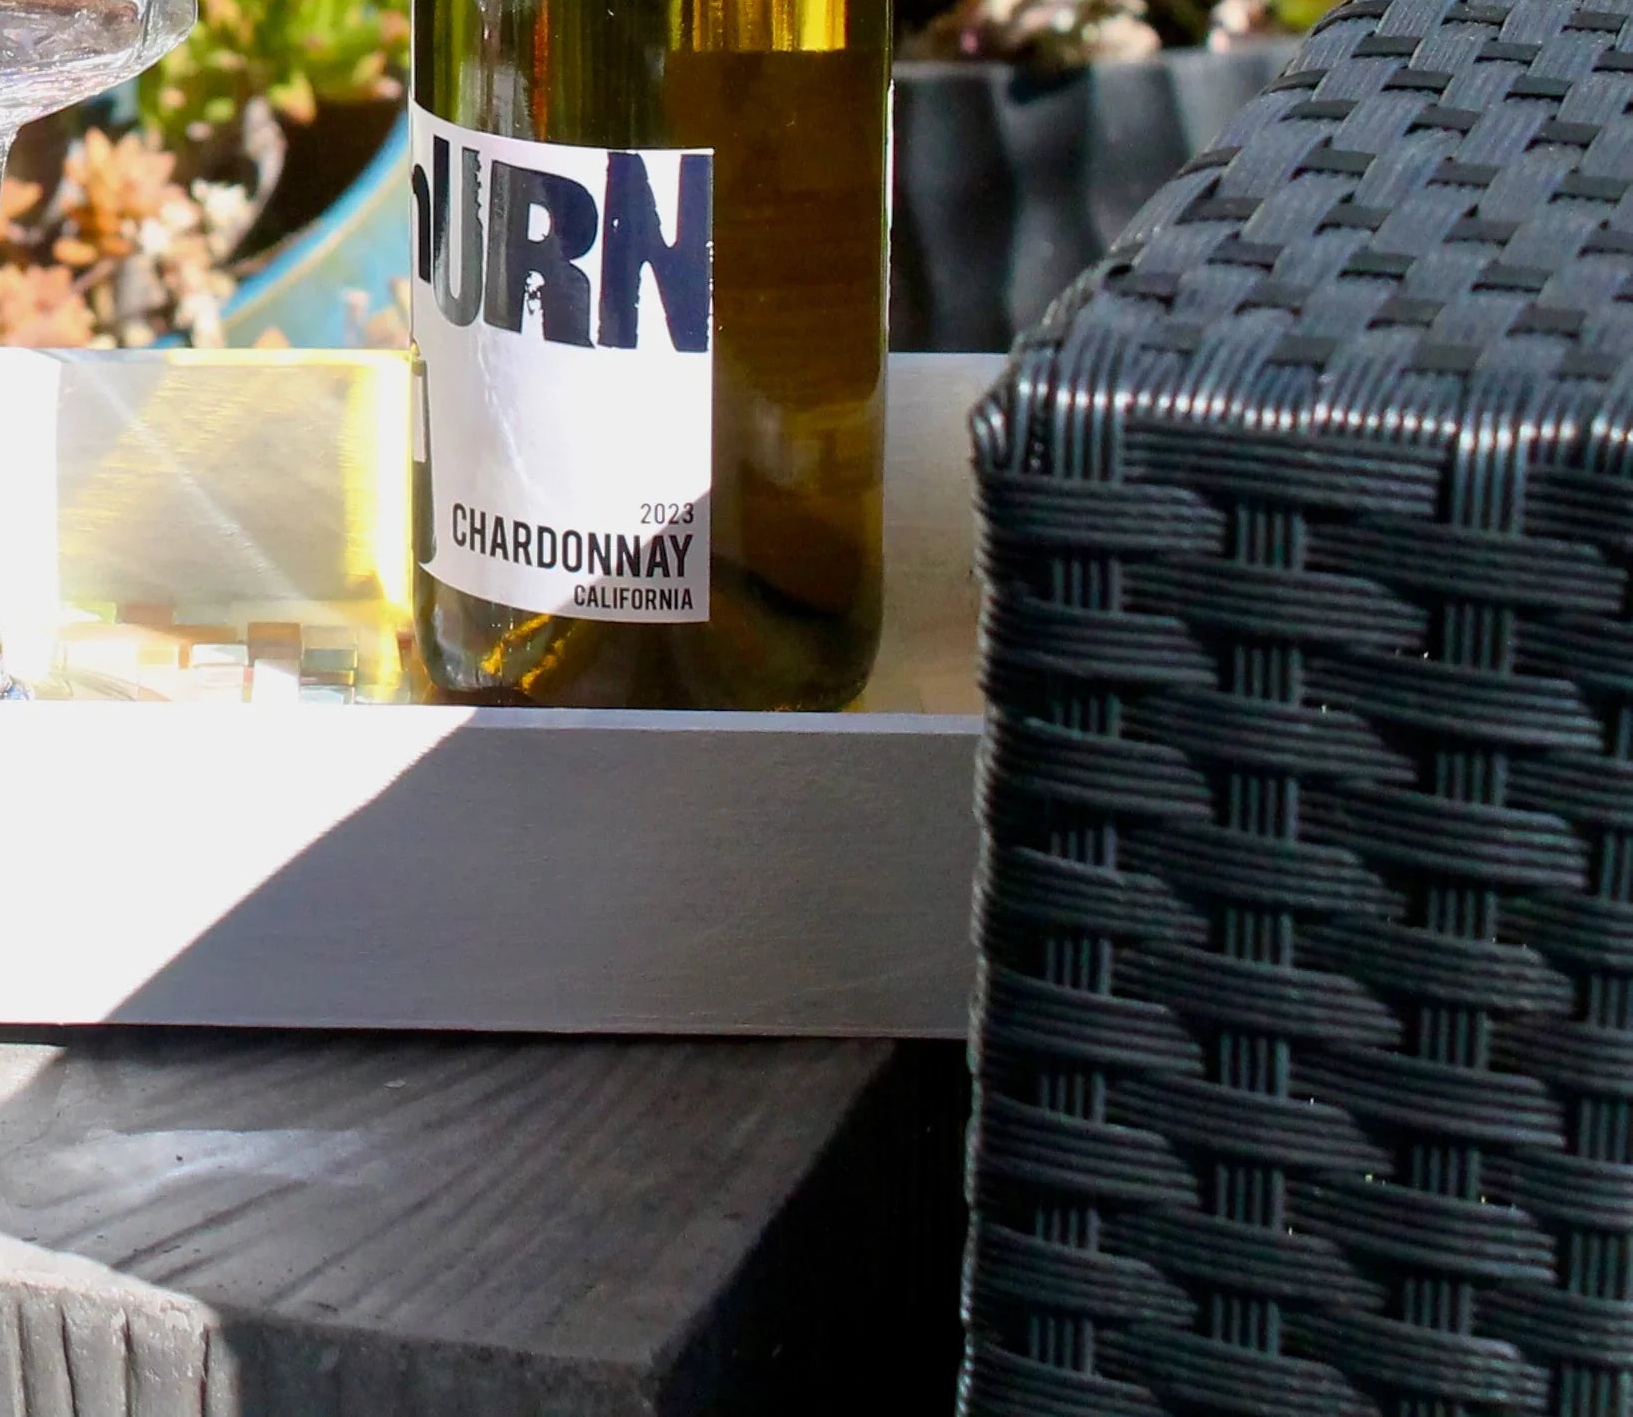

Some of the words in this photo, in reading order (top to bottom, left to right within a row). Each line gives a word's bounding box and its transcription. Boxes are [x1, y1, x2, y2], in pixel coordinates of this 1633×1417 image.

[640, 503, 694, 524] 2023
[452, 503, 693, 577] CHARDONNAY
[574, 585, 693, 610] CALIFORNIA
